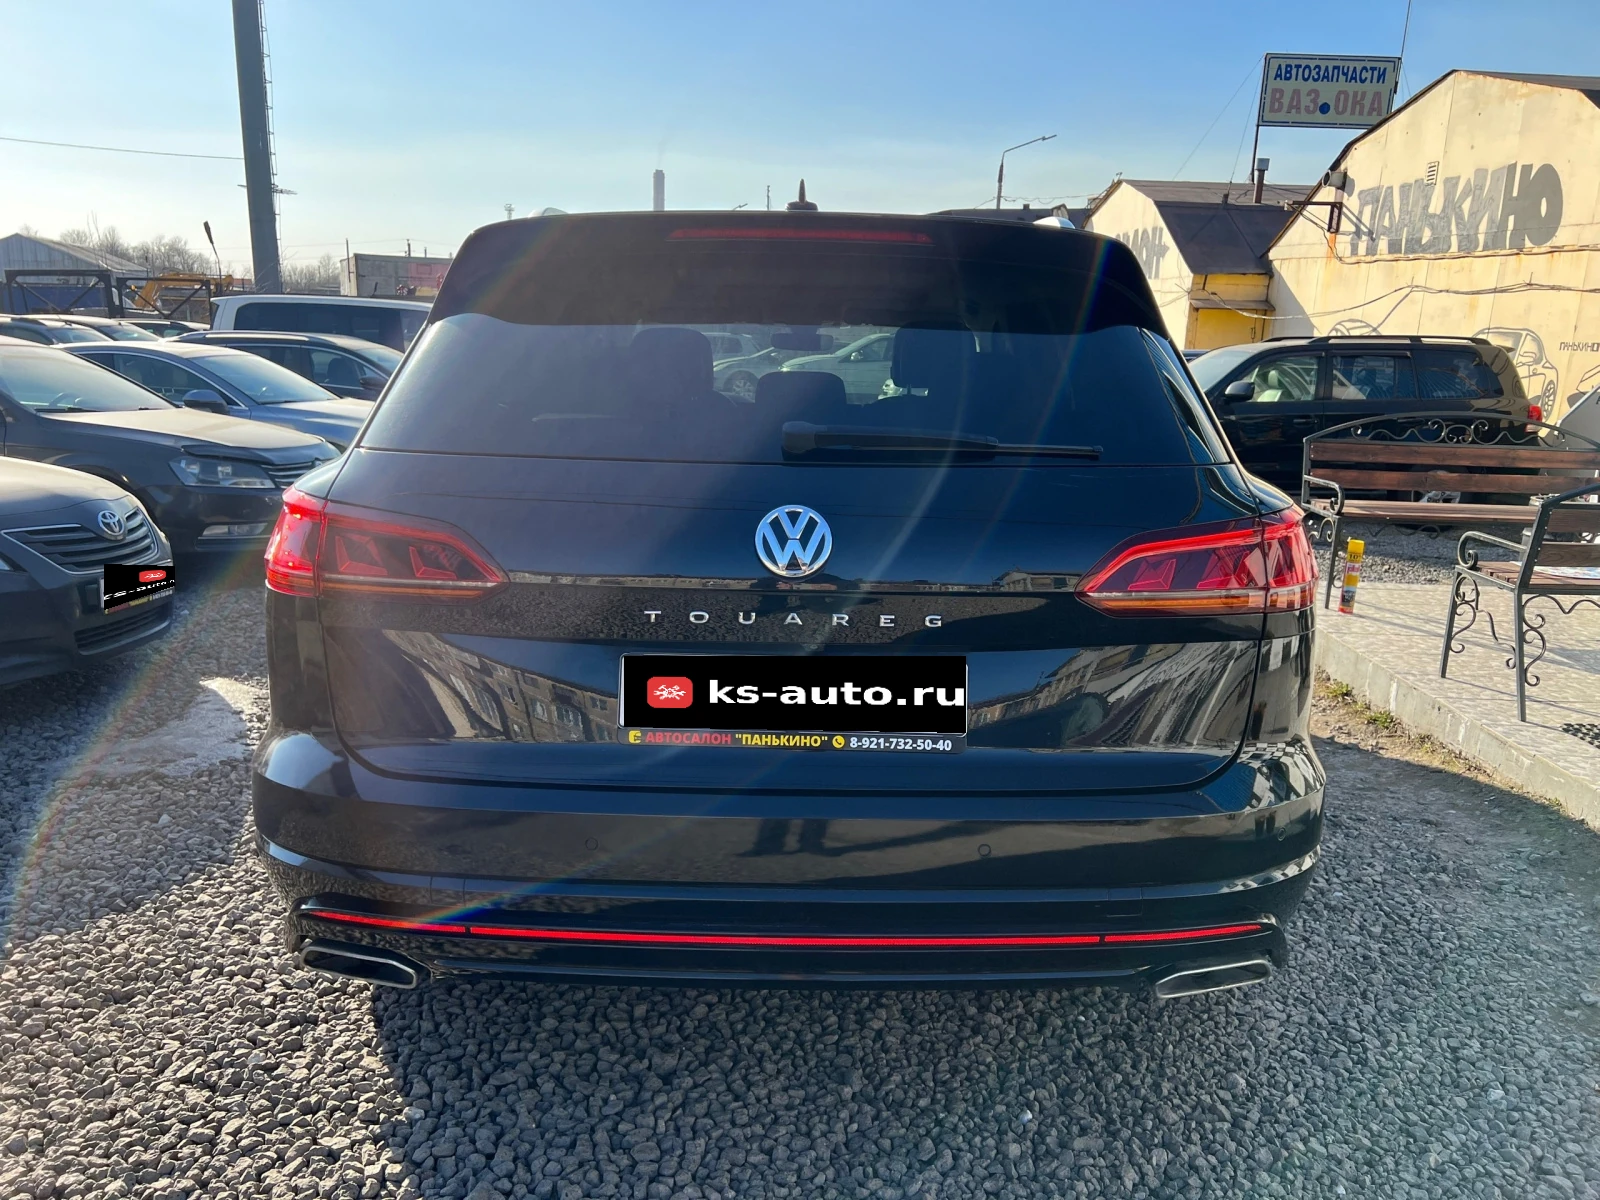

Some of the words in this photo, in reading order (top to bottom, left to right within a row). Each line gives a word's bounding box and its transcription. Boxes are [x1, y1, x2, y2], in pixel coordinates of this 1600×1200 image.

[1274, 64, 1388, 84] АВТОЗАПЧАСТИ
[1268, 88, 1320, 115] ВАЗ
[1334, 90, 1383, 117] ОКА
[1350, 161, 1564, 257] ПАНЬКИНО
[644, 611, 943, 628] TOUAREG
[645, 731, 732, 744] АВТОСАЛОН
[735, 733, 828, 747] "ПАНЬКИНО"
[849, 736, 952, 751] 8-921-732-50-40
